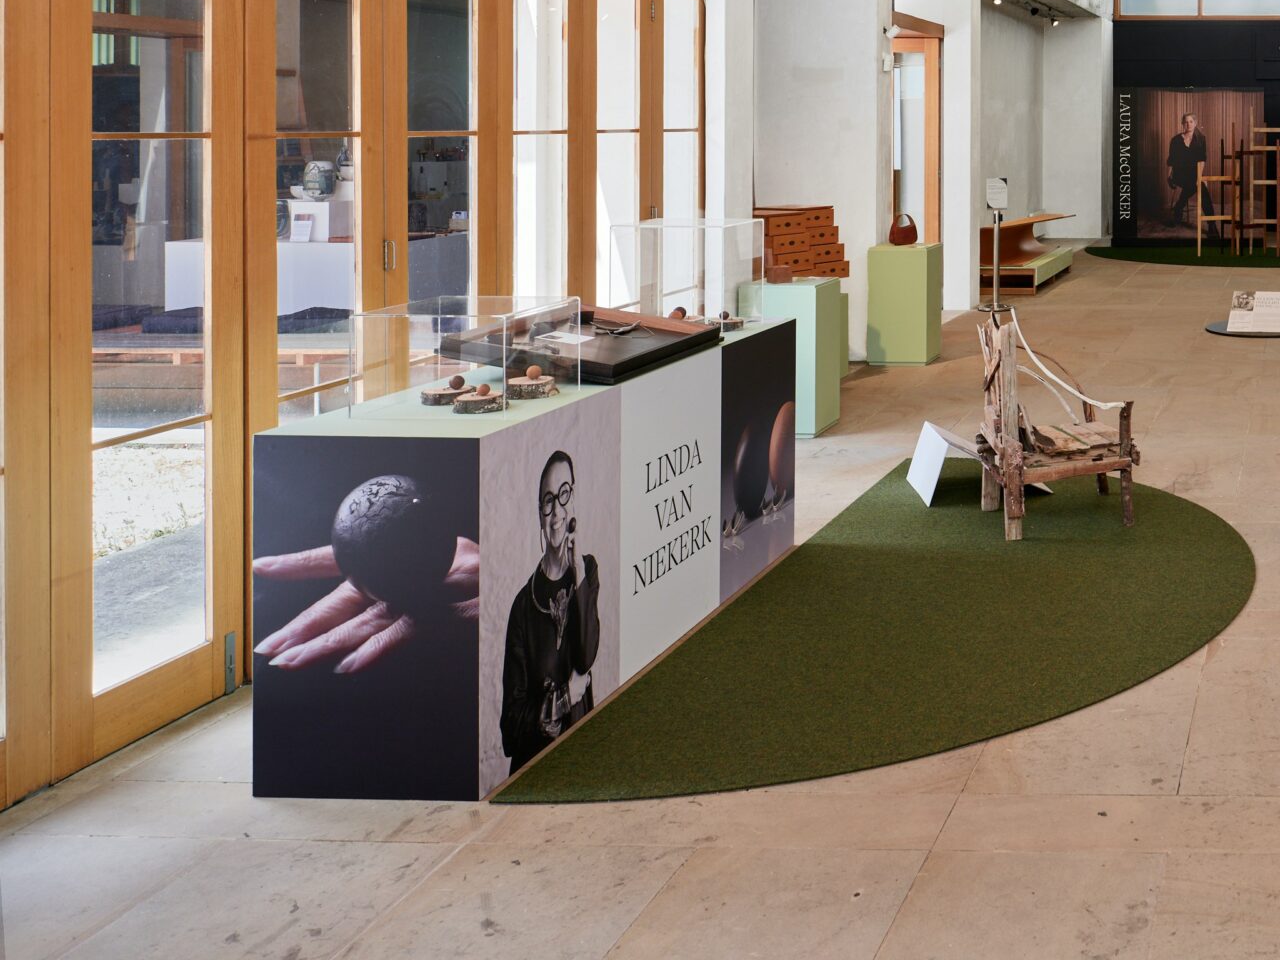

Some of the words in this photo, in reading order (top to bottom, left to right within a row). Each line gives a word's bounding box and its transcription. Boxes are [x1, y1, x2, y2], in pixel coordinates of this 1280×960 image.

[1120, 94, 1130, 142] LAURA
[1120, 145, 1130, 220] McCUSKER
[645, 439, 702, 494] LINDA
[654, 484, 694, 531] VAN
[633, 515, 712, 596] NIEKERK
